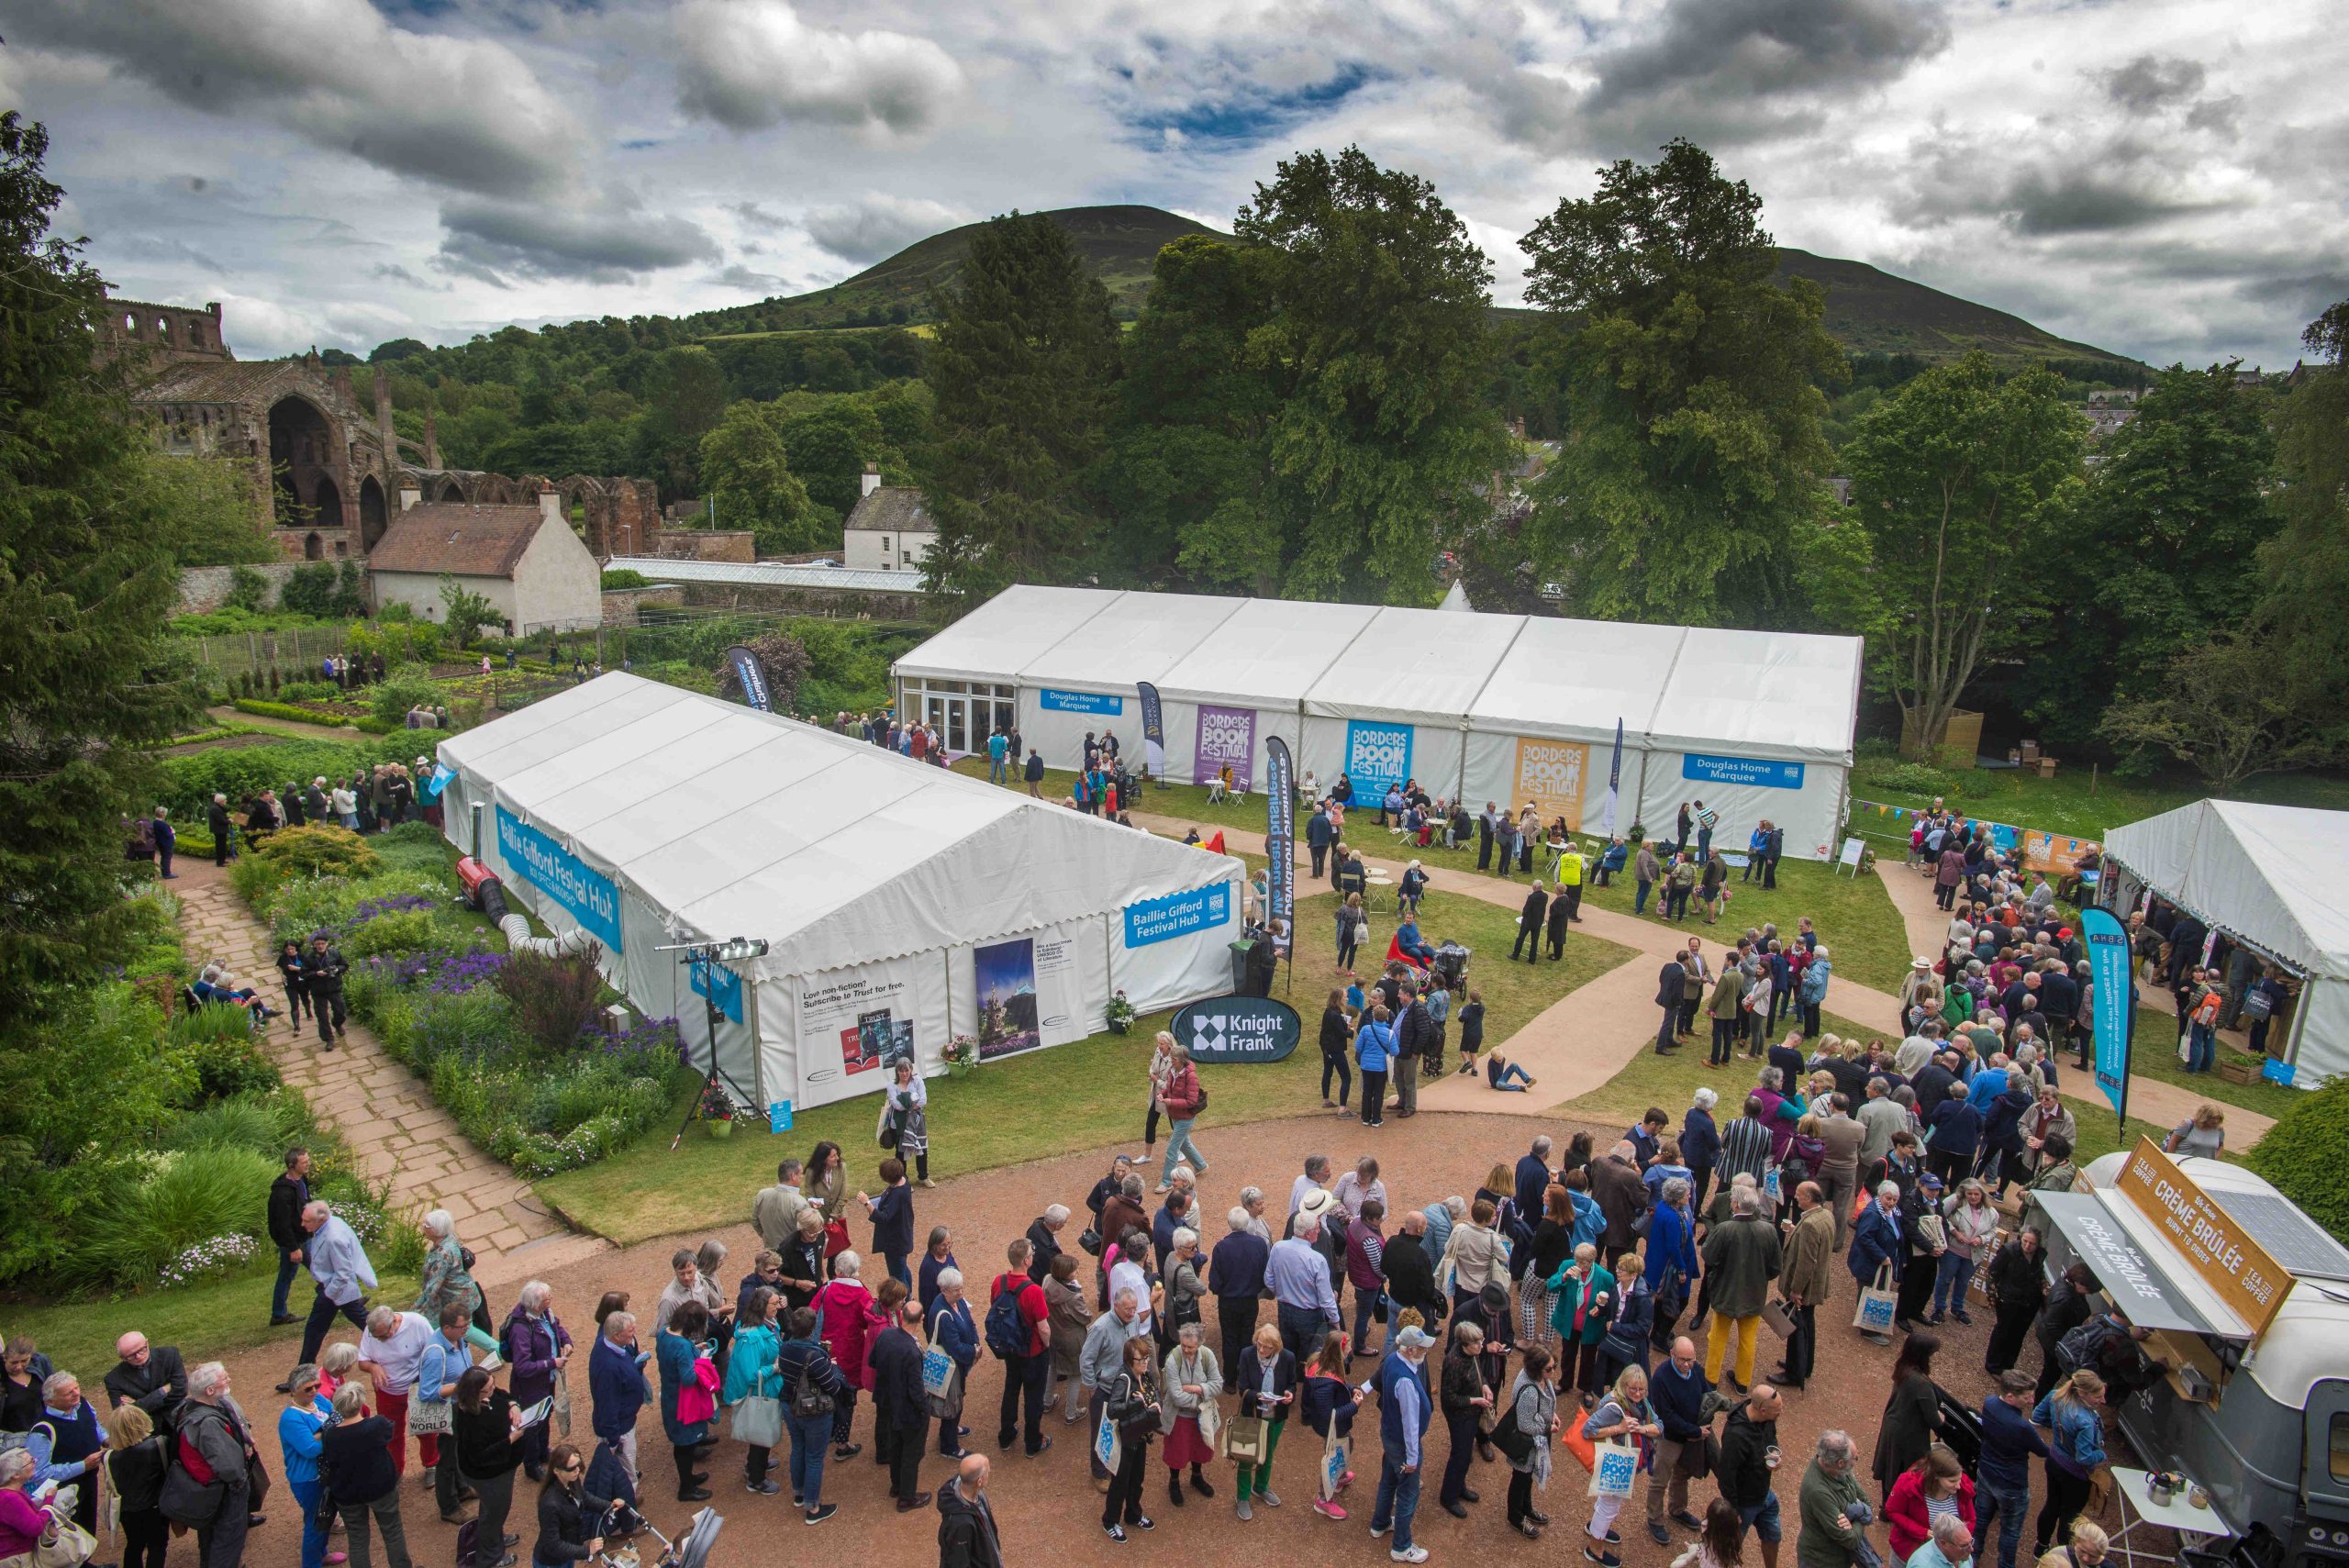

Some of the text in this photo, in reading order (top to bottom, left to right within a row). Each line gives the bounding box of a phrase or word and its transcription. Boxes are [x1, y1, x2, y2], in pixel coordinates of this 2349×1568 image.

[1050, 692, 1079, 702] Douglas
[1079, 695, 1100, 704] Home
[1059, 700, 1091, 711] Marquee
[1202, 726, 1250, 746] BOOK
[1353, 743, 1406, 763] BOOK
[1521, 760, 1581, 782] BOOK
[1697, 759, 1739, 772] Douglas
[1741, 762, 1771, 773] Home
[1710, 770, 1755, 782] Marquee
[523, 837, 554, 878] Gifford
[589, 884, 613, 924] Hub
[1133, 910, 1166, 926] Baillie
[1168, 898, 1203, 917] Gifford
[1137, 913, 1200, 939] Festival Hub
[803, 980, 867, 1000] Love non-fiction?
[804, 994, 841, 1008] Subscribe
[853, 988, 874, 998] Trust
[888, 982, 905, 991] free.
[864, 1013, 885, 1023] TRUST
[1230, 1014, 1283, 1035] Knight
[1230, 1034, 1275, 1051] Frank
[2138, 1157, 2149, 1173] TEA
[2132, 1165, 2153, 1187] COFFEE
[2154, 1180, 2244, 1275] CRÈME BRÛLÉE
[2165, 1216, 2210, 1265] BURNT TO ORDER
[2248, 1267, 2262, 1286] TEA
[2242, 1276, 2268, 1305] COFFEE
[410, 1420, 447, 1430] WORLD
[1601, 1461, 1634, 1475] BOOK
